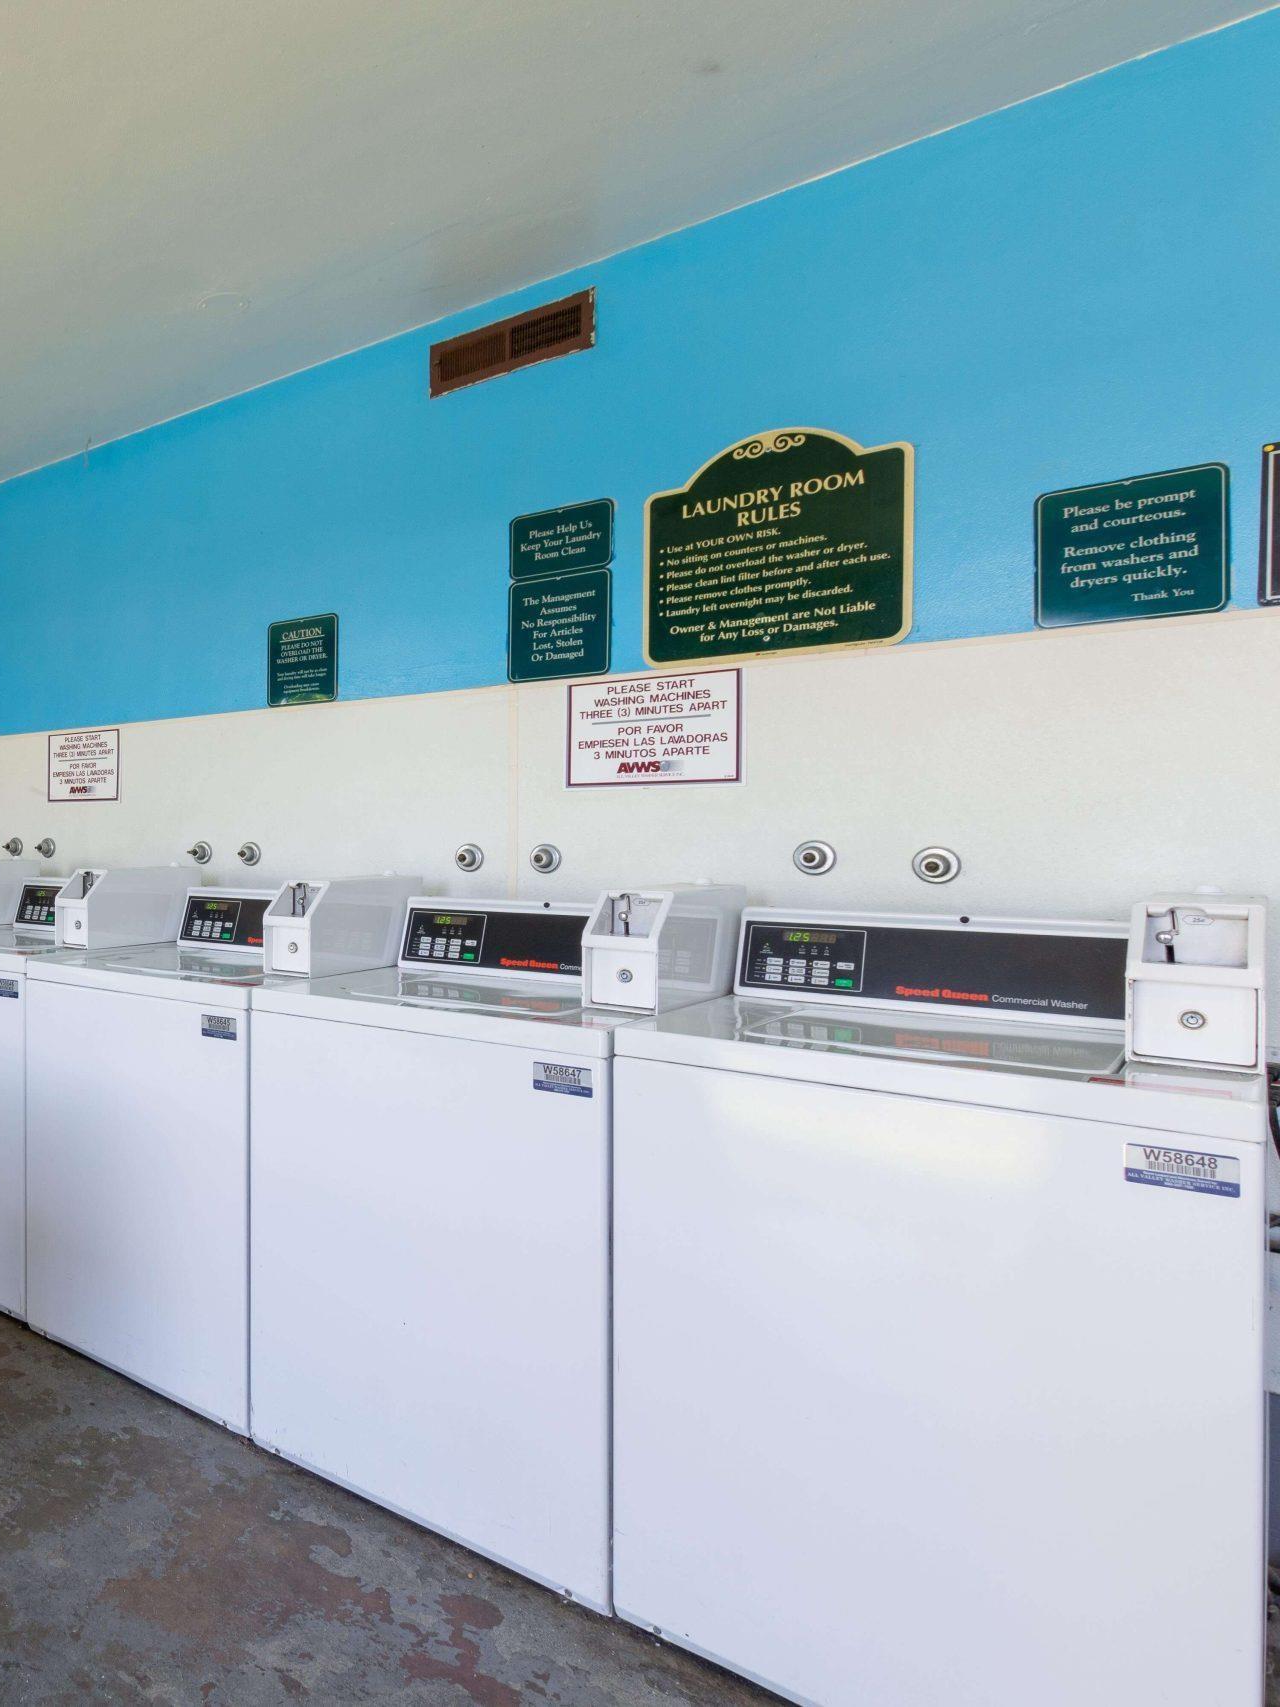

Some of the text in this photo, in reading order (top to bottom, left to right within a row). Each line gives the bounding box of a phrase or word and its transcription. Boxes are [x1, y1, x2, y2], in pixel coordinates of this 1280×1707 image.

[683, 469, 864, 519] LAUNDRY ROOM
[1063, 489, 1196, 519] Please be prompt
[738, 501, 801, 527] RULES
[1071, 510, 1186, 533] and courteous.
[529, 520, 592, 539] Please Help Us
[521, 531, 601, 552] Keep Your Laundry
[667, 528, 781, 554] Use at YOUR OWN RISK.
[682, 554, 708, 564] sitting
[724, 545, 763, 557] counters
[779, 535, 827, 548] machines.
[1064, 532, 1196, 558] Remove clothing
[535, 546, 586, 561] Room Clean
[667, 570, 693, 579] Please
[695, 566, 706, 575] do
[709, 564, 723, 572] not
[726, 556, 766, 570] overload
[768, 554, 784, 563] the
[786, 549, 821, 560] washer
[837, 542, 868, 553] dryer.
[1061, 544, 1199, 574] from washers and
[667, 553, 891, 592] Please clean lint filter before and after each use.
[1070, 565, 1187, 588] dryers quickly.
[523, 590, 595, 606] The Management
[666, 577, 811, 605] Please remove clothes promptly.
[666, 584, 853, 617] Laundry left overnight may be discarded.
[1131, 588, 1194, 602] Thank You
[540, 605, 577, 616] Assumes
[670, 601, 876, 635] Owner & Management are Not Liable
[522, 613, 596, 629] No Responsibility
[700, 633, 715, 642] for
[718, 631, 738, 641] Any
[742, 629, 764, 637] Loss
[783, 620, 839, 632] Damages.
[533, 626, 583, 639] For Articles
[533, 638, 583, 650] Lost, Stolen
[531, 648, 584, 662] Or Damaged
[607, 679, 695, 695] PLEASE START
[594, 689, 711, 707] WASHING MACHINES
[580, 700, 727, 720] THREE (3) MINUTES APART
[618, 724, 683, 736] POR FAVOR
[578, 732, 728, 749] EMPIESEN LAS LAVADORAS
[594, 746, 710, 760] 3 MINUTOS APARTE
[617, 761, 661, 774] AVWS
[500, 957, 529, 967] Speed
[529, 959, 559, 970] Queen
[895, 985, 1089, 1010] Speed Queen Commercial Washer
[543, 1064, 582, 1078] W58647
[1143, 1148, 1218, 1170] W58648
